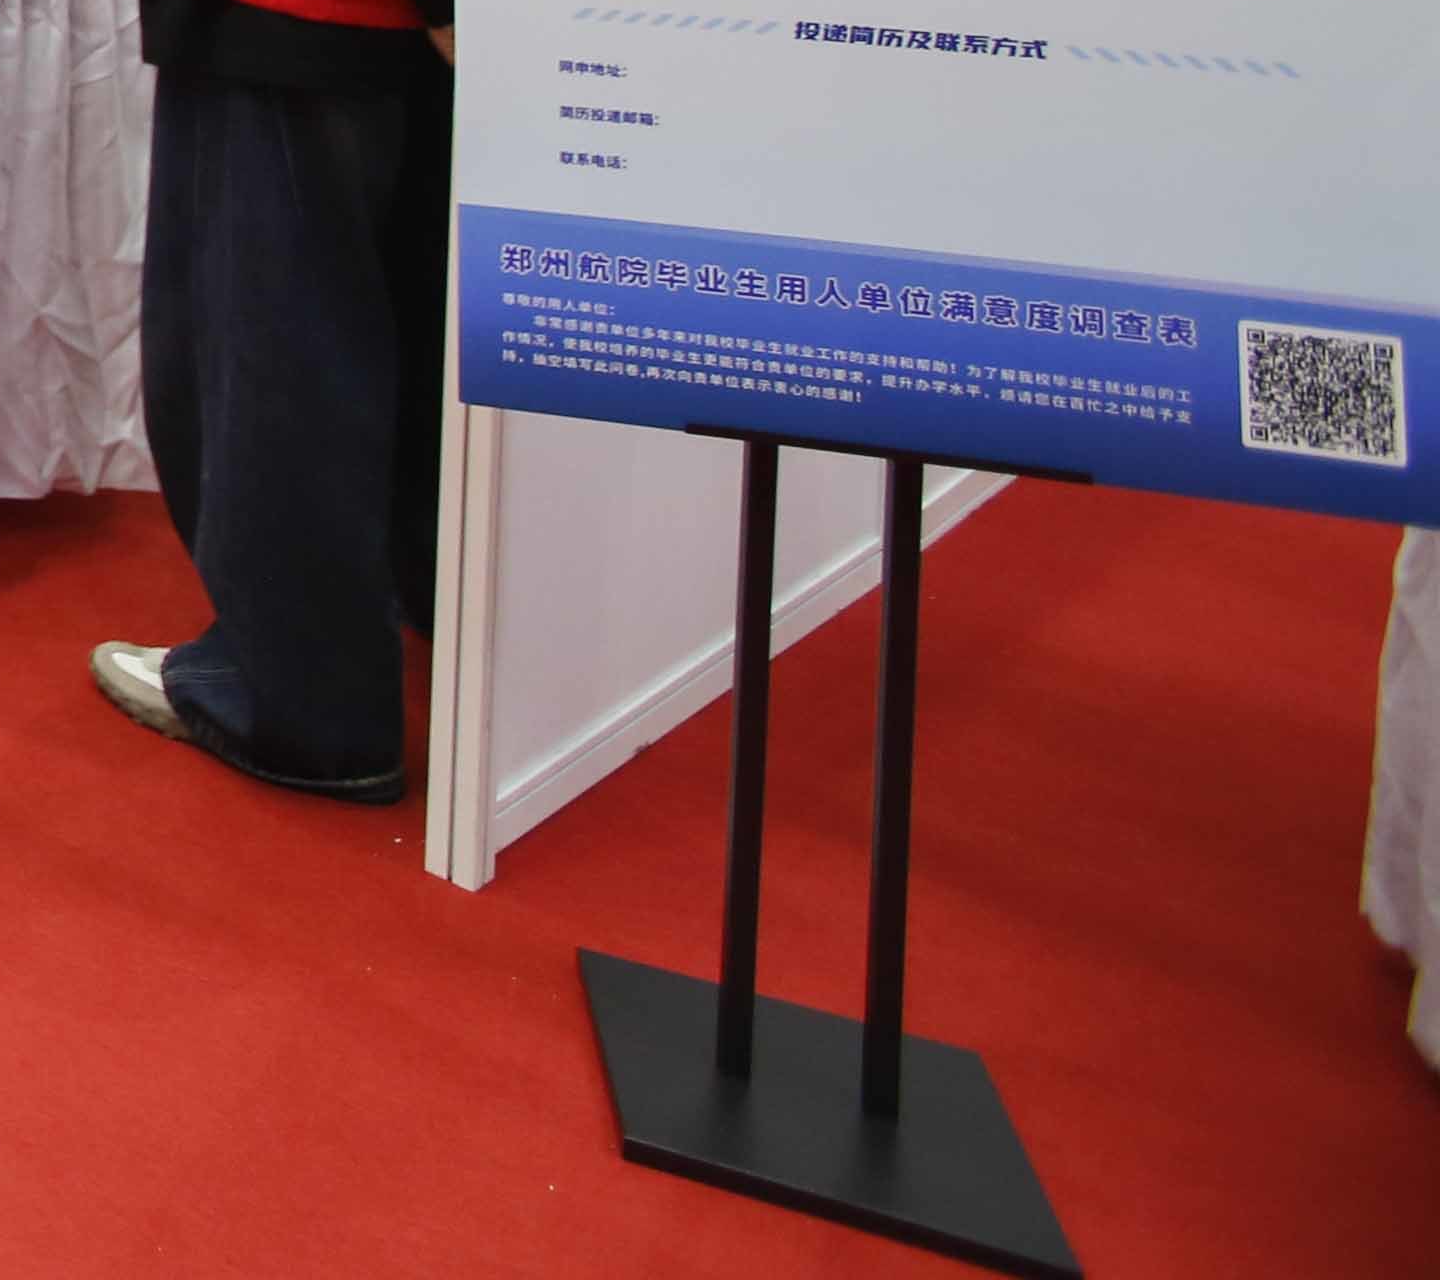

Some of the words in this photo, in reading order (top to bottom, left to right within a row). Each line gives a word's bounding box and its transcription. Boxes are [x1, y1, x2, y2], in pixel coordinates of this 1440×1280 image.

[793, 20, 1049, 60] 投递简历及联系方式
[501, 243, 1197, 347] 郑州航院毕业生用人单位满意度调查表
